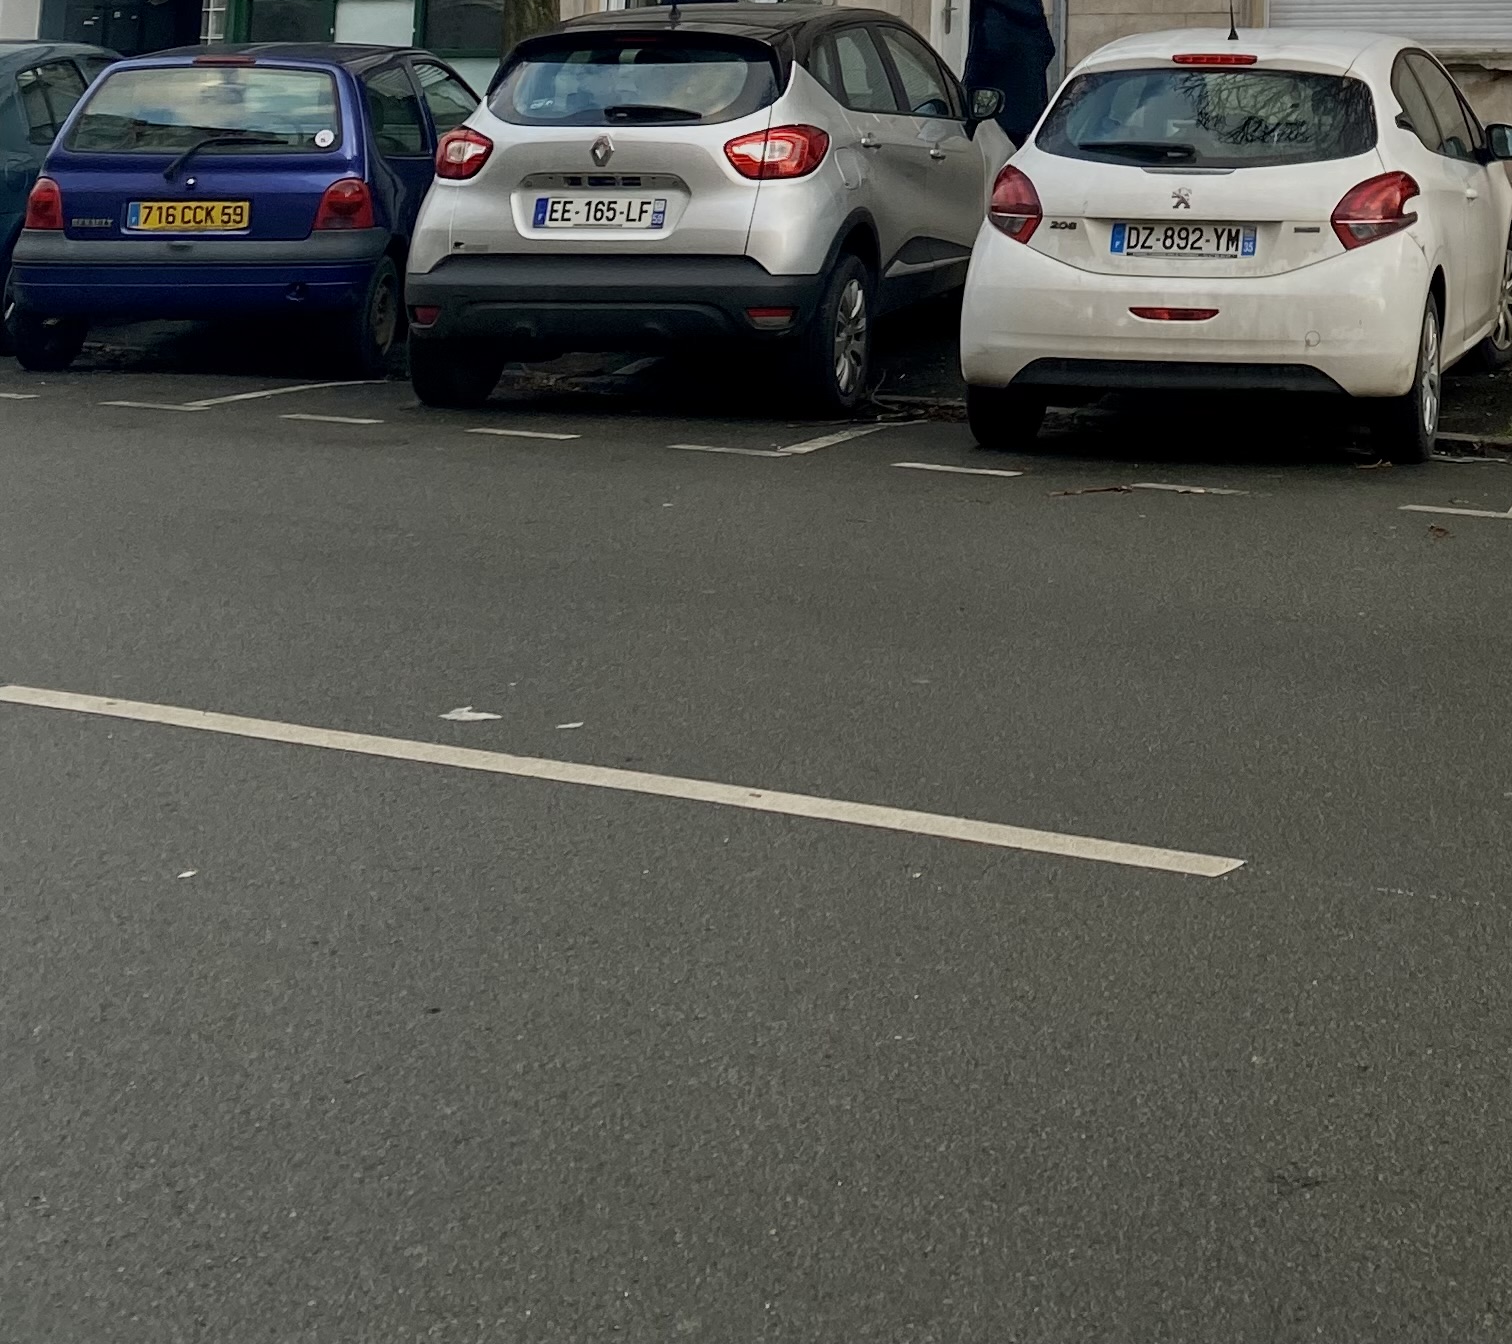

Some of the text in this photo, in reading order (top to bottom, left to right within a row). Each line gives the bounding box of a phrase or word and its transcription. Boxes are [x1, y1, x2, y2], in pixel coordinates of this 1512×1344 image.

[142, 205, 244, 225] 716 CCK 59
[548, 201, 652, 222] EE-165-LF
[1127, 226, 1240, 252] DZ-892-YM
